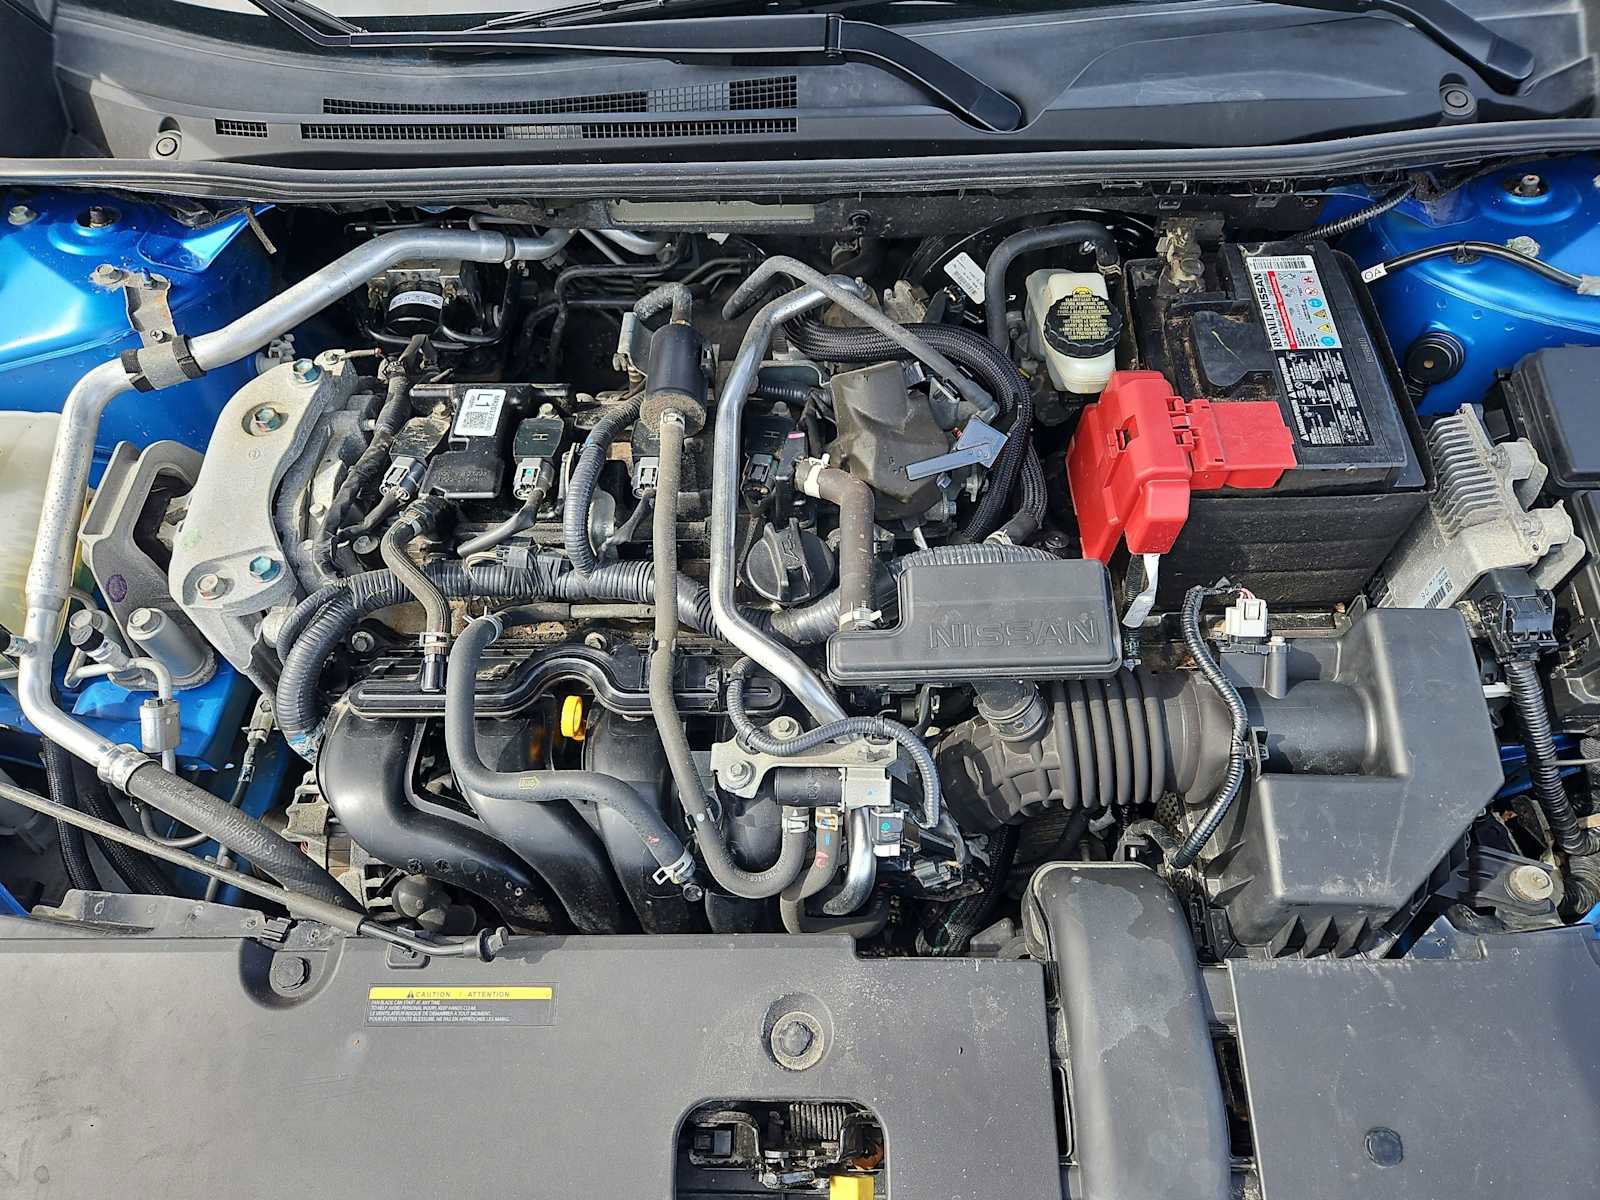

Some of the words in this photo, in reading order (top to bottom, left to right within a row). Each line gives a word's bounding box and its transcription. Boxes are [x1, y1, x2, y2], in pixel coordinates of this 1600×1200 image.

[1253, 273, 1272, 310] NISSAN
[1265, 313, 1283, 348] RENAULT
[475, 393, 493, 407] L1
[929, 618, 1101, 649] NISSAN
